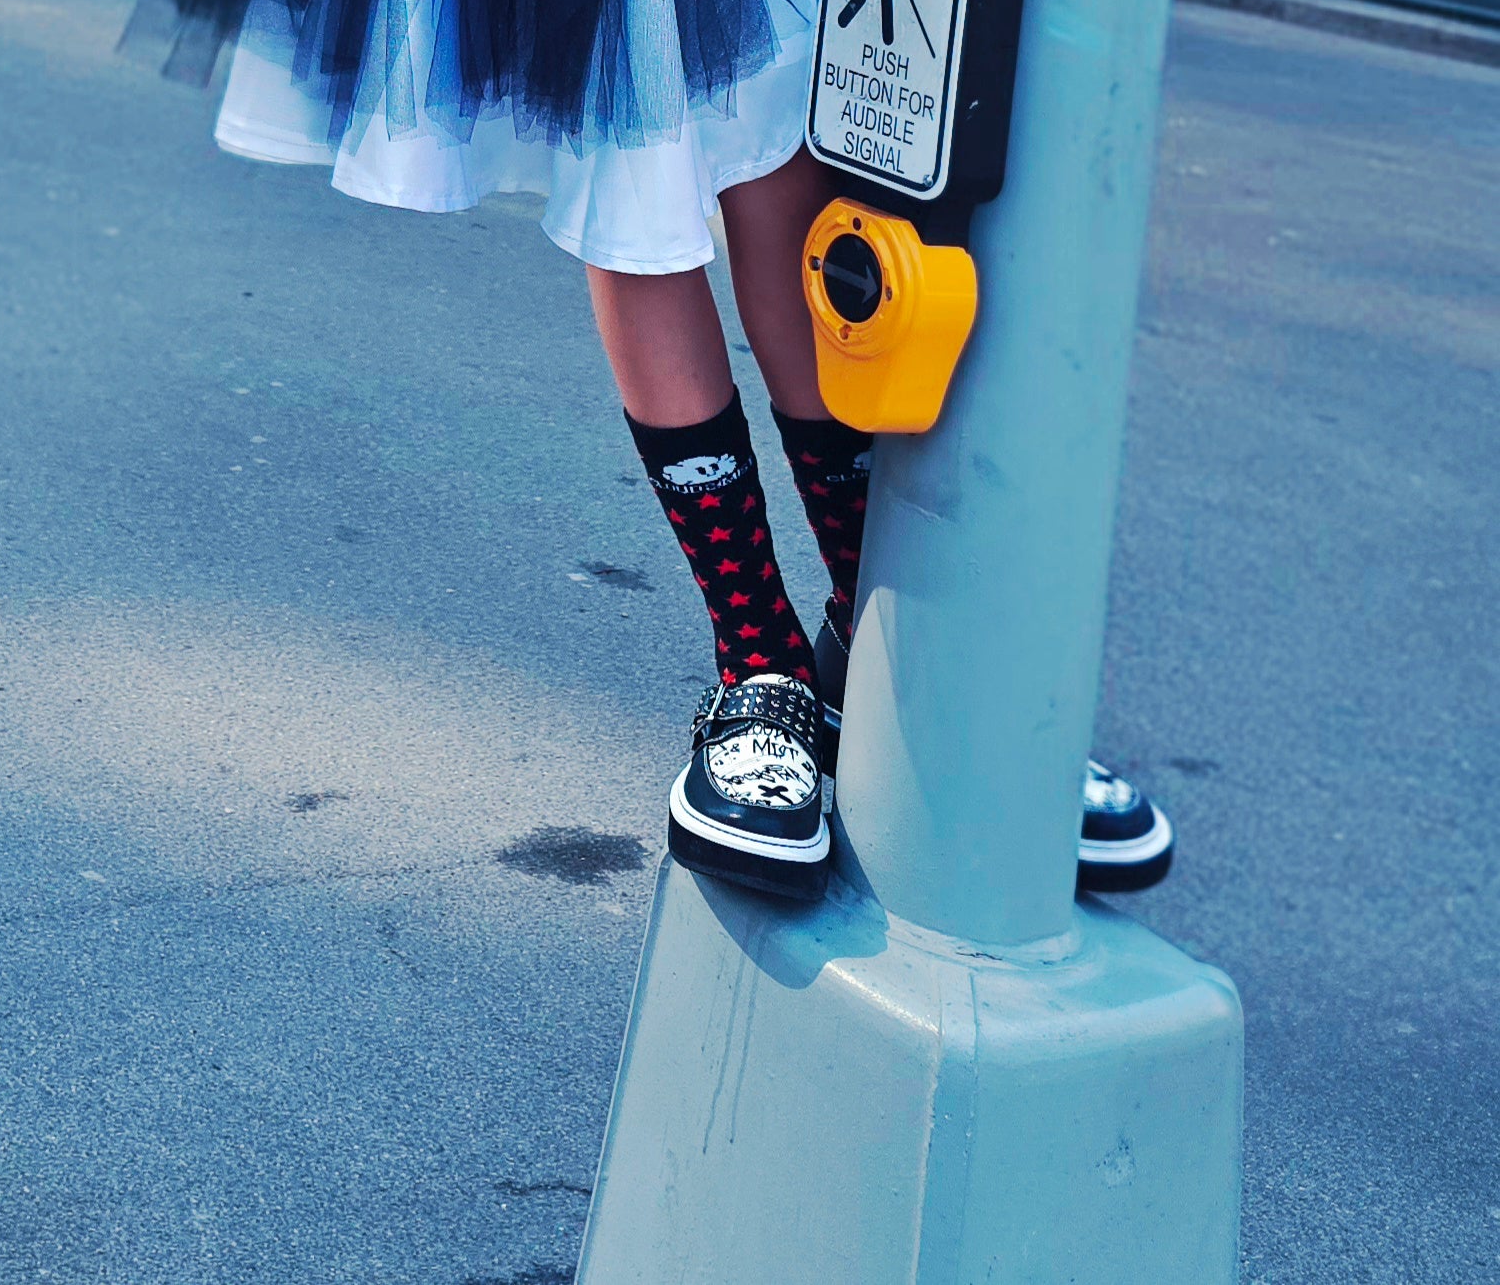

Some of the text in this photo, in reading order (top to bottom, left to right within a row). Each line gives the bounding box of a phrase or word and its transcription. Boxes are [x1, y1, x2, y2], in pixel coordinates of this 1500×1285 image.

[861, 43, 909, 80] PUSH
[824, 63, 935, 121] BUTTON FOR
[840, 100, 914, 145] AUDIBLE
[843, 131, 905, 174] SIGNAL
